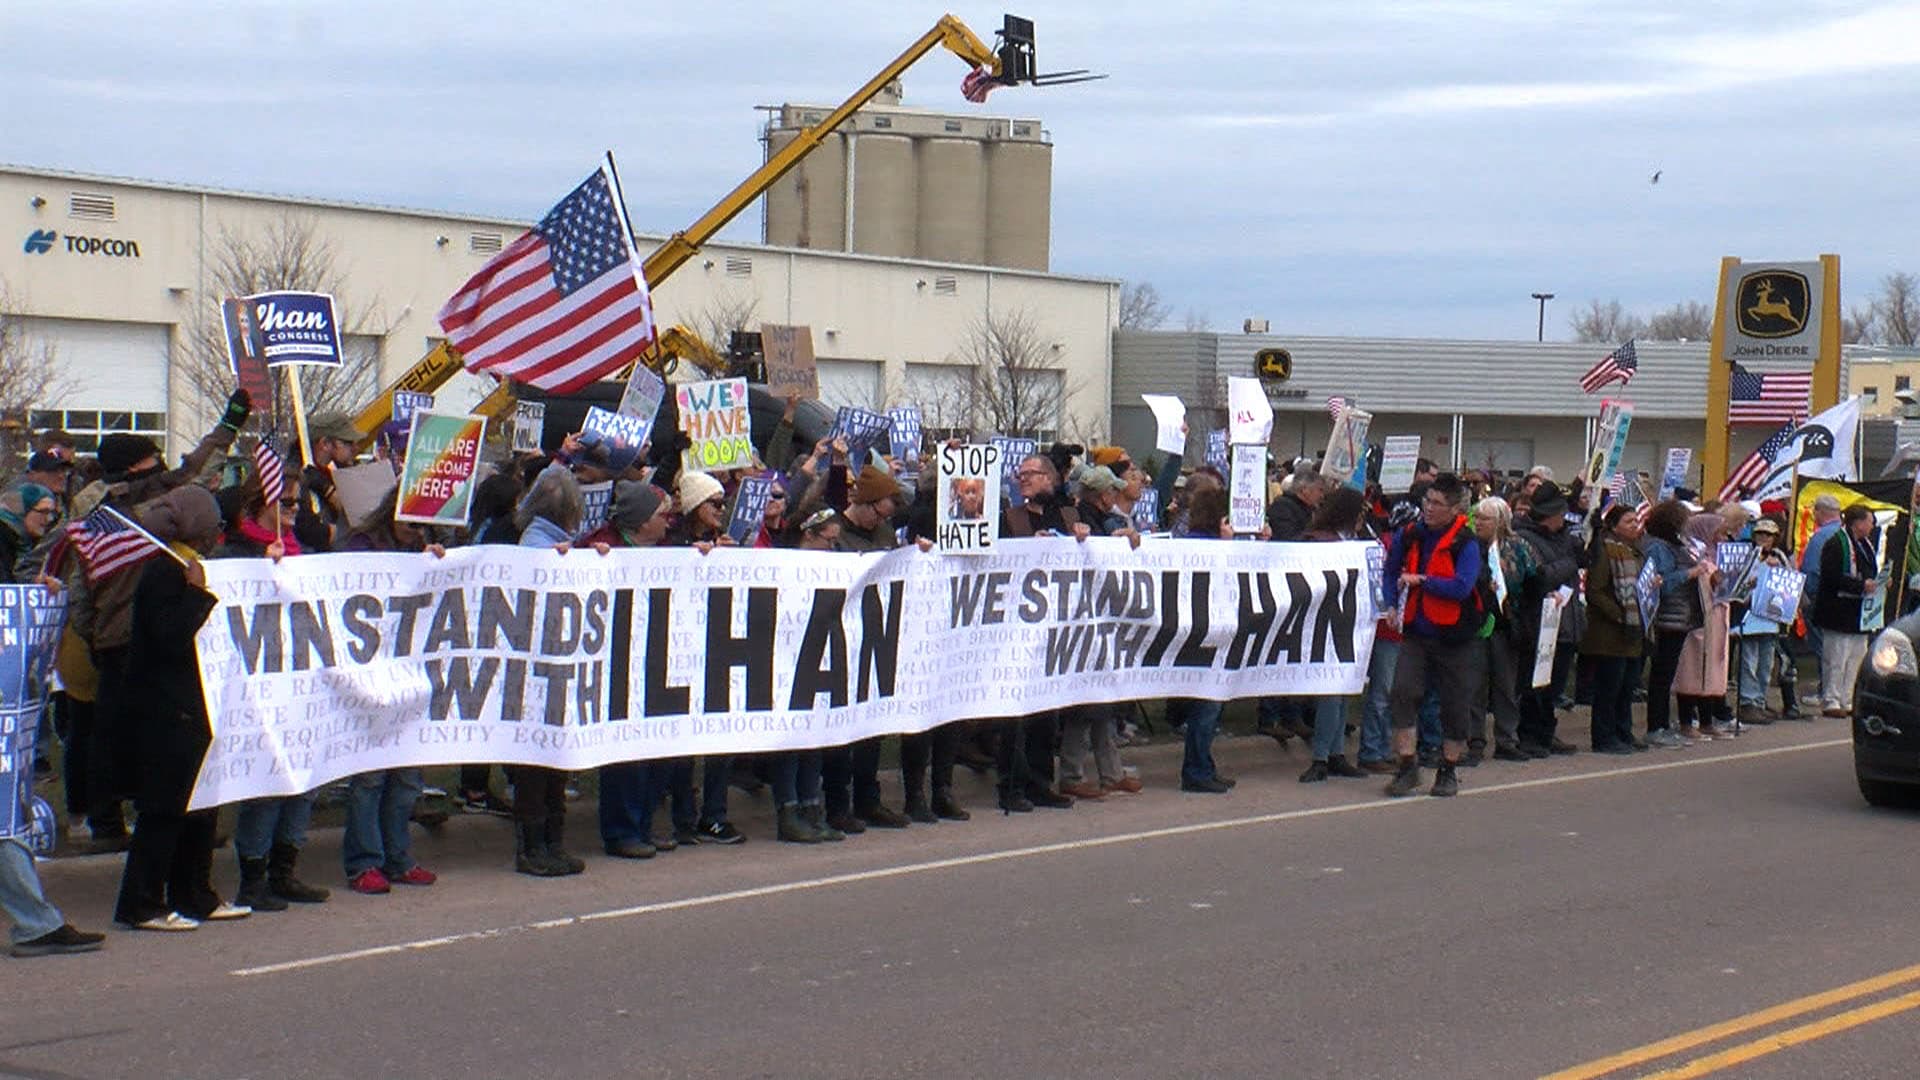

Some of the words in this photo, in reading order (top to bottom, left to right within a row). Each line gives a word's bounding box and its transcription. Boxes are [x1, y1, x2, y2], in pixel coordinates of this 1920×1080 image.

[64, 235, 140, 257] TOPCON
[256, 302, 327, 331] lhan
[1733, 344, 1764, 356] JOHN
[1765, 344, 1809, 355] DEERE
[688, 383, 733, 411] WE
[685, 406, 748, 439] HAVE
[416, 435, 442, 453] ALL
[446, 439, 475, 457] ARE
[688, 437, 751, 468] ROOM
[942, 444, 997, 476] STOP
[413, 459, 471, 477] WELCOME
[408, 477, 451, 499] HERE
[745, 481, 771, 495] STA
[748, 495, 766, 509] WI
[737, 507, 765, 521] ILH
[940, 522, 991, 550] HATE
[224, 579, 280, 598] NITY
[421, 563, 513, 586] JUSTICE
[641, 566, 681, 582] LOVE
[694, 566, 780, 582] RESPECT
[951, 571, 1012, 629] WE
[1018, 568, 1155, 624] STAND
[226, 599, 337, 676] MN
[341, 585, 608, 665] STANDS
[1140, 568, 1359, 671] ILHAN
[608, 579, 904, 721] ILHAN
[1045, 621, 1152, 677] WITH
[425, 656, 603, 727] WITH
[418, 725, 494, 744] UNITY
[692, 714, 812, 736] DEMOCRACY
